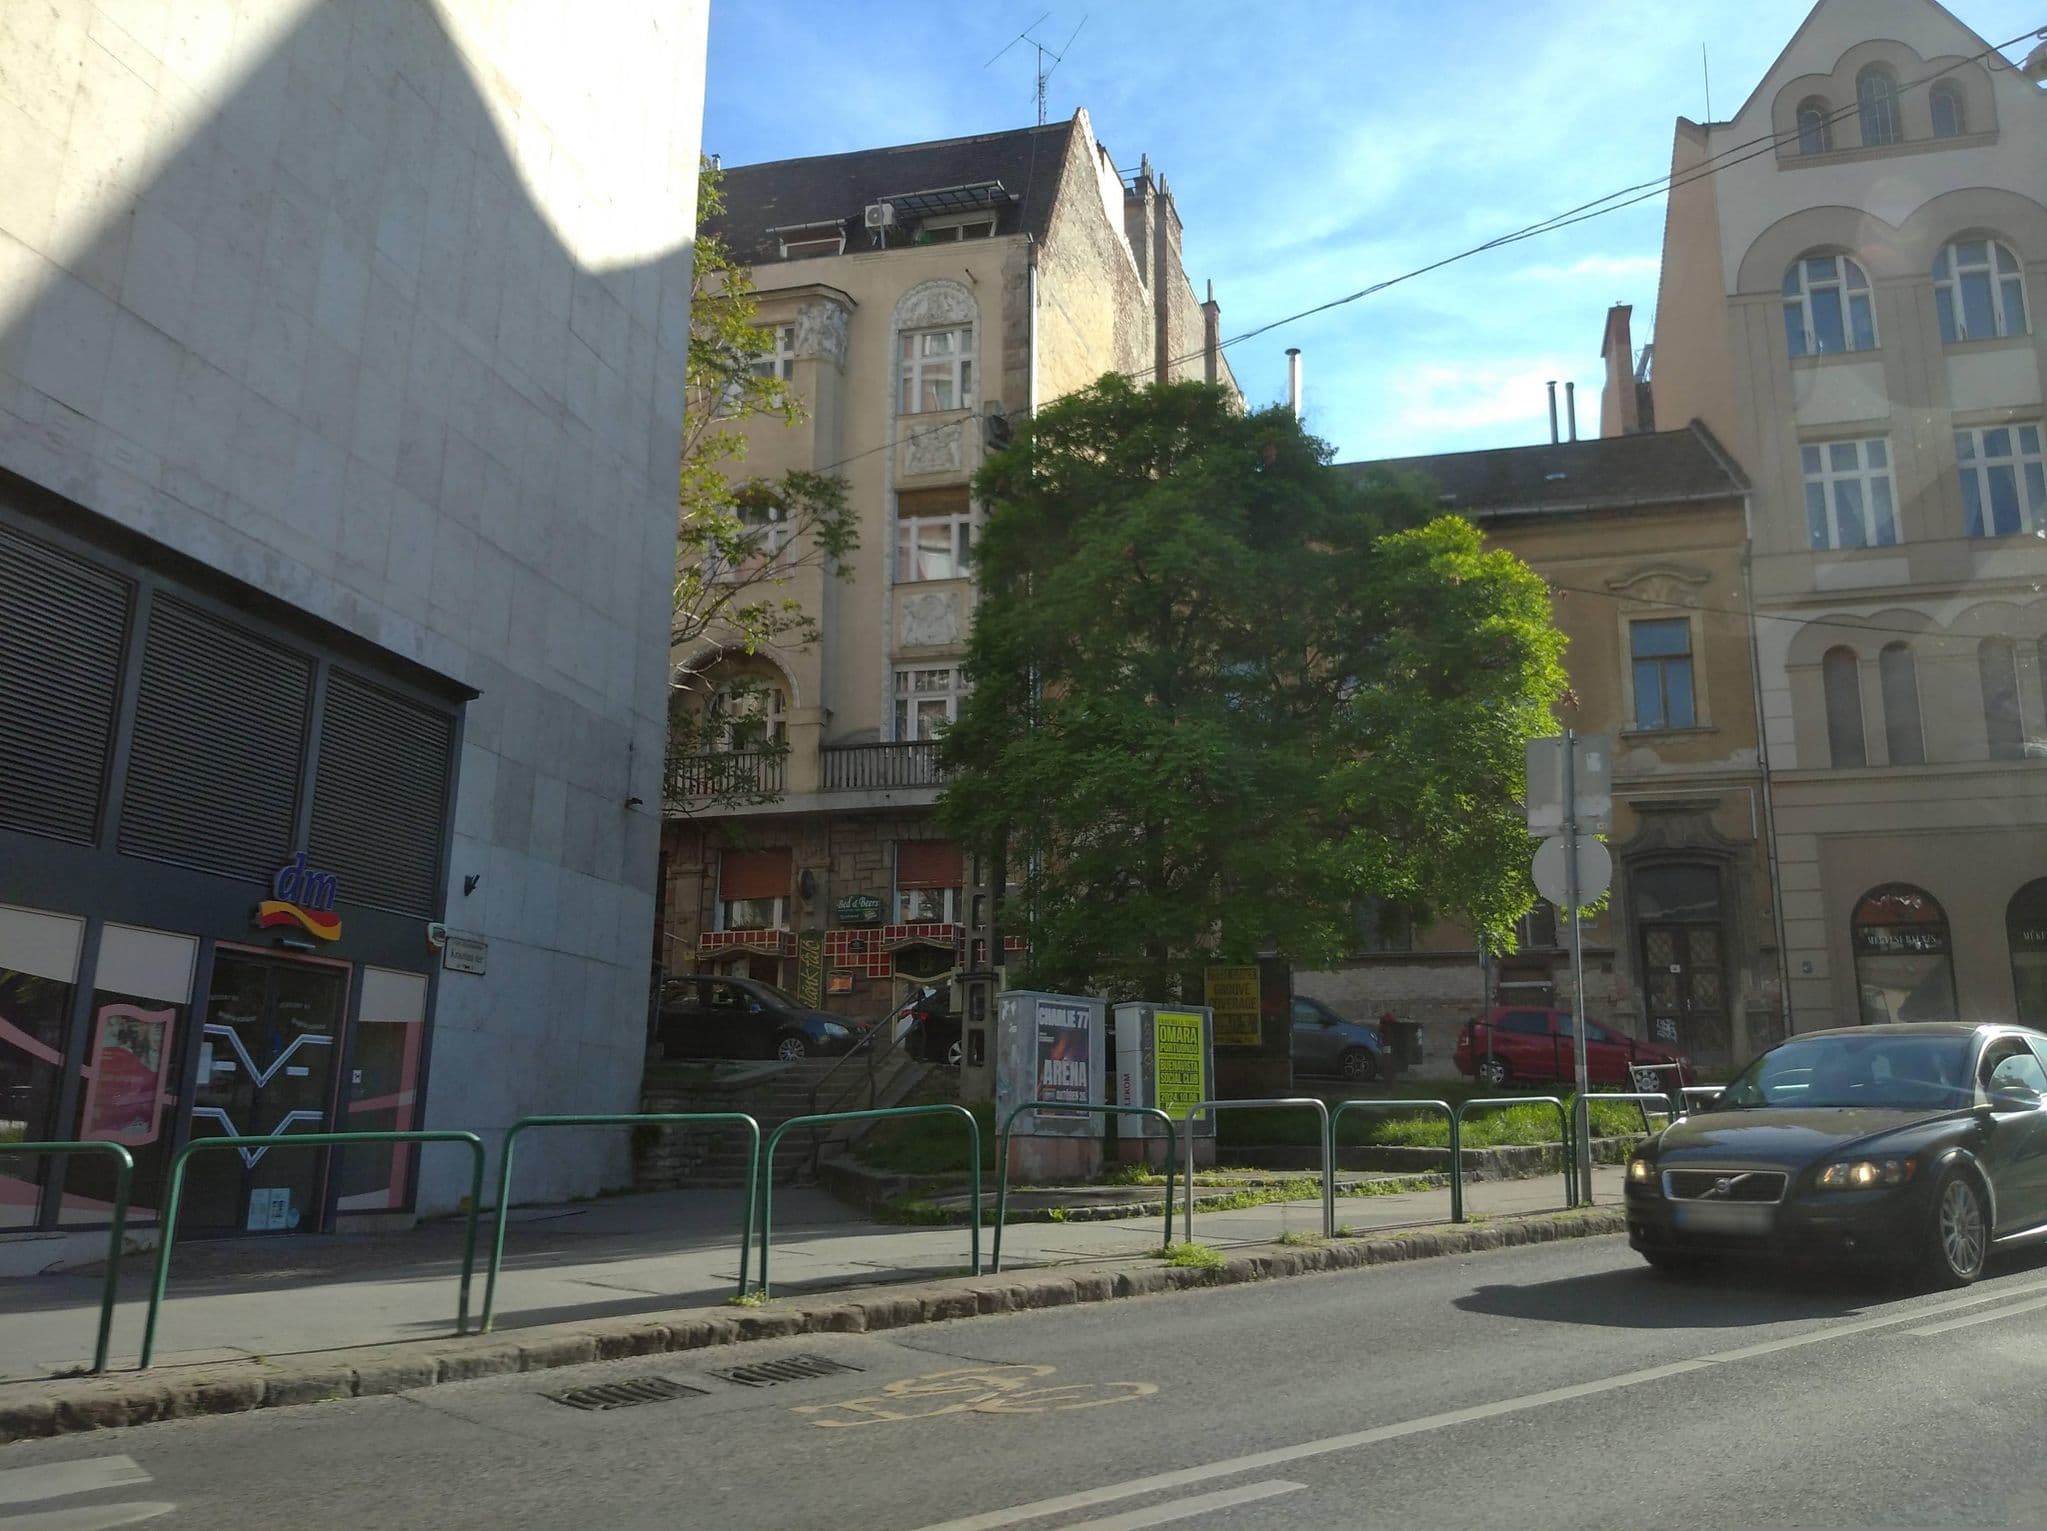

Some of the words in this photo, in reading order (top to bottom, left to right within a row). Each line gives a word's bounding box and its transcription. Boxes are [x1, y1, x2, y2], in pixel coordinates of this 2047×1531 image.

[276, 850, 338, 911] dm
[1159, 1025, 1198, 1044] OMARA
[1160, 1072, 1182, 1083] SOCIAL
[1182, 1073, 1198, 1084] CLUB
